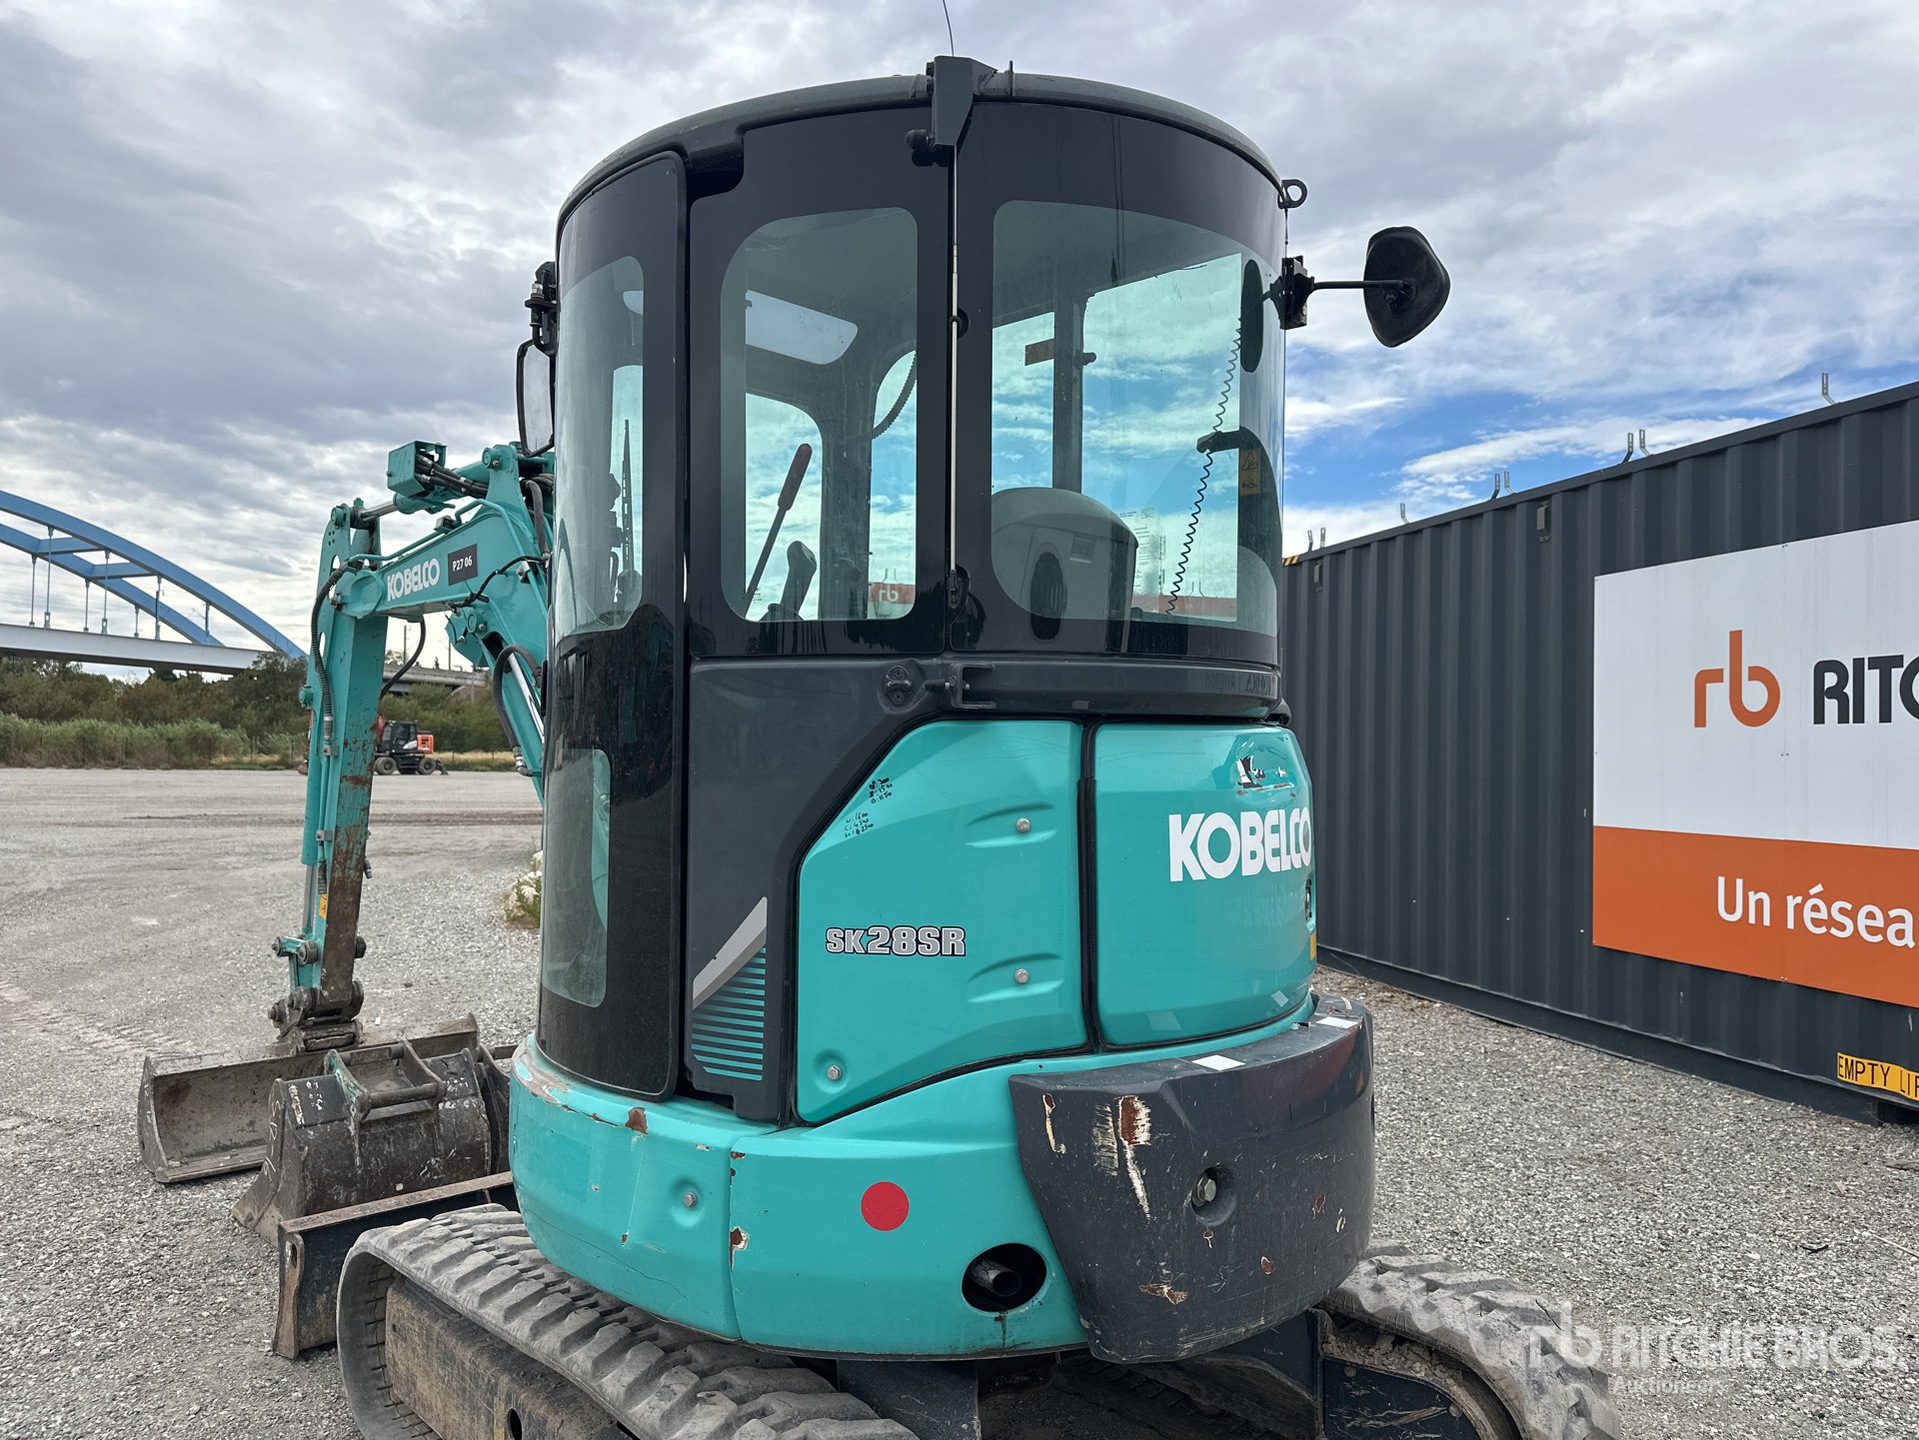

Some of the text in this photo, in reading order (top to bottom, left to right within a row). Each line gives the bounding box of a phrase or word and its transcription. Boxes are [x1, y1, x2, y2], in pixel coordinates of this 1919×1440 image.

[387, 558, 440, 602] KOBELCO
[452, 558, 464, 572] P27
[1694, 629, 1781, 728] rb
[1168, 806, 1312, 882] KOBELCO
[1717, 875, 1916, 949] Un résea
[825, 925, 966, 957] SK28SR
[1838, 1055, 1891, 1087] EMPTY
